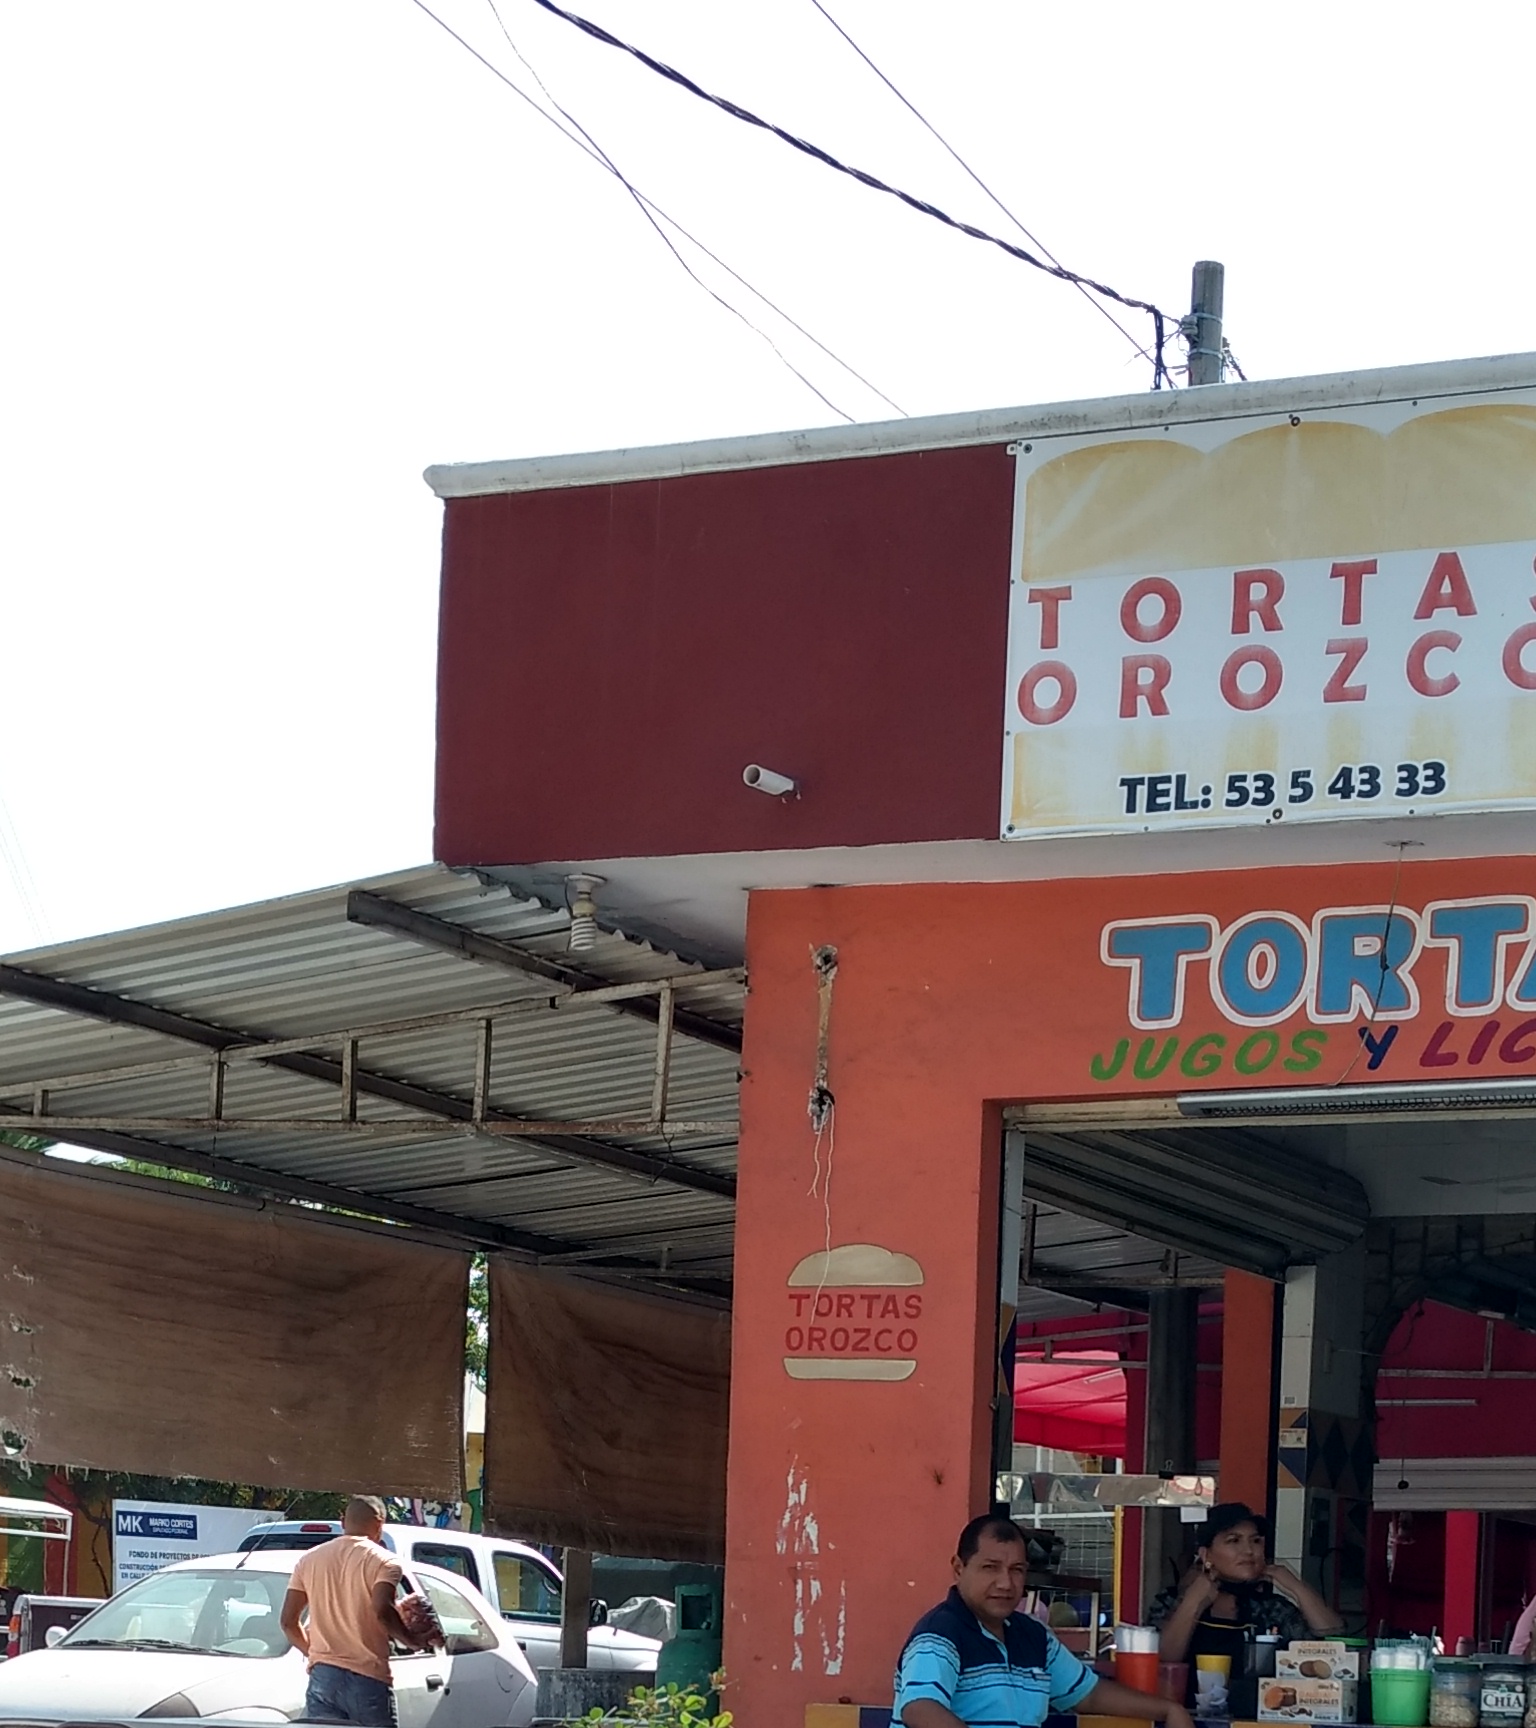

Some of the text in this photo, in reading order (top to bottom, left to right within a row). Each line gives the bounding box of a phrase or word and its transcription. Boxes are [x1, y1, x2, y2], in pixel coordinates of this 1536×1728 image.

[1119, 761, 1447, 814] TEL: 53 5 43 33
[1089, 1029, 1330, 1082] JUGOS
[1357, 1024, 1399, 1071] Y
[788, 1292, 924, 1321] TORTAS
[784, 1325, 919, 1353] OROZCO
[118, 1514, 144, 1533] MK
